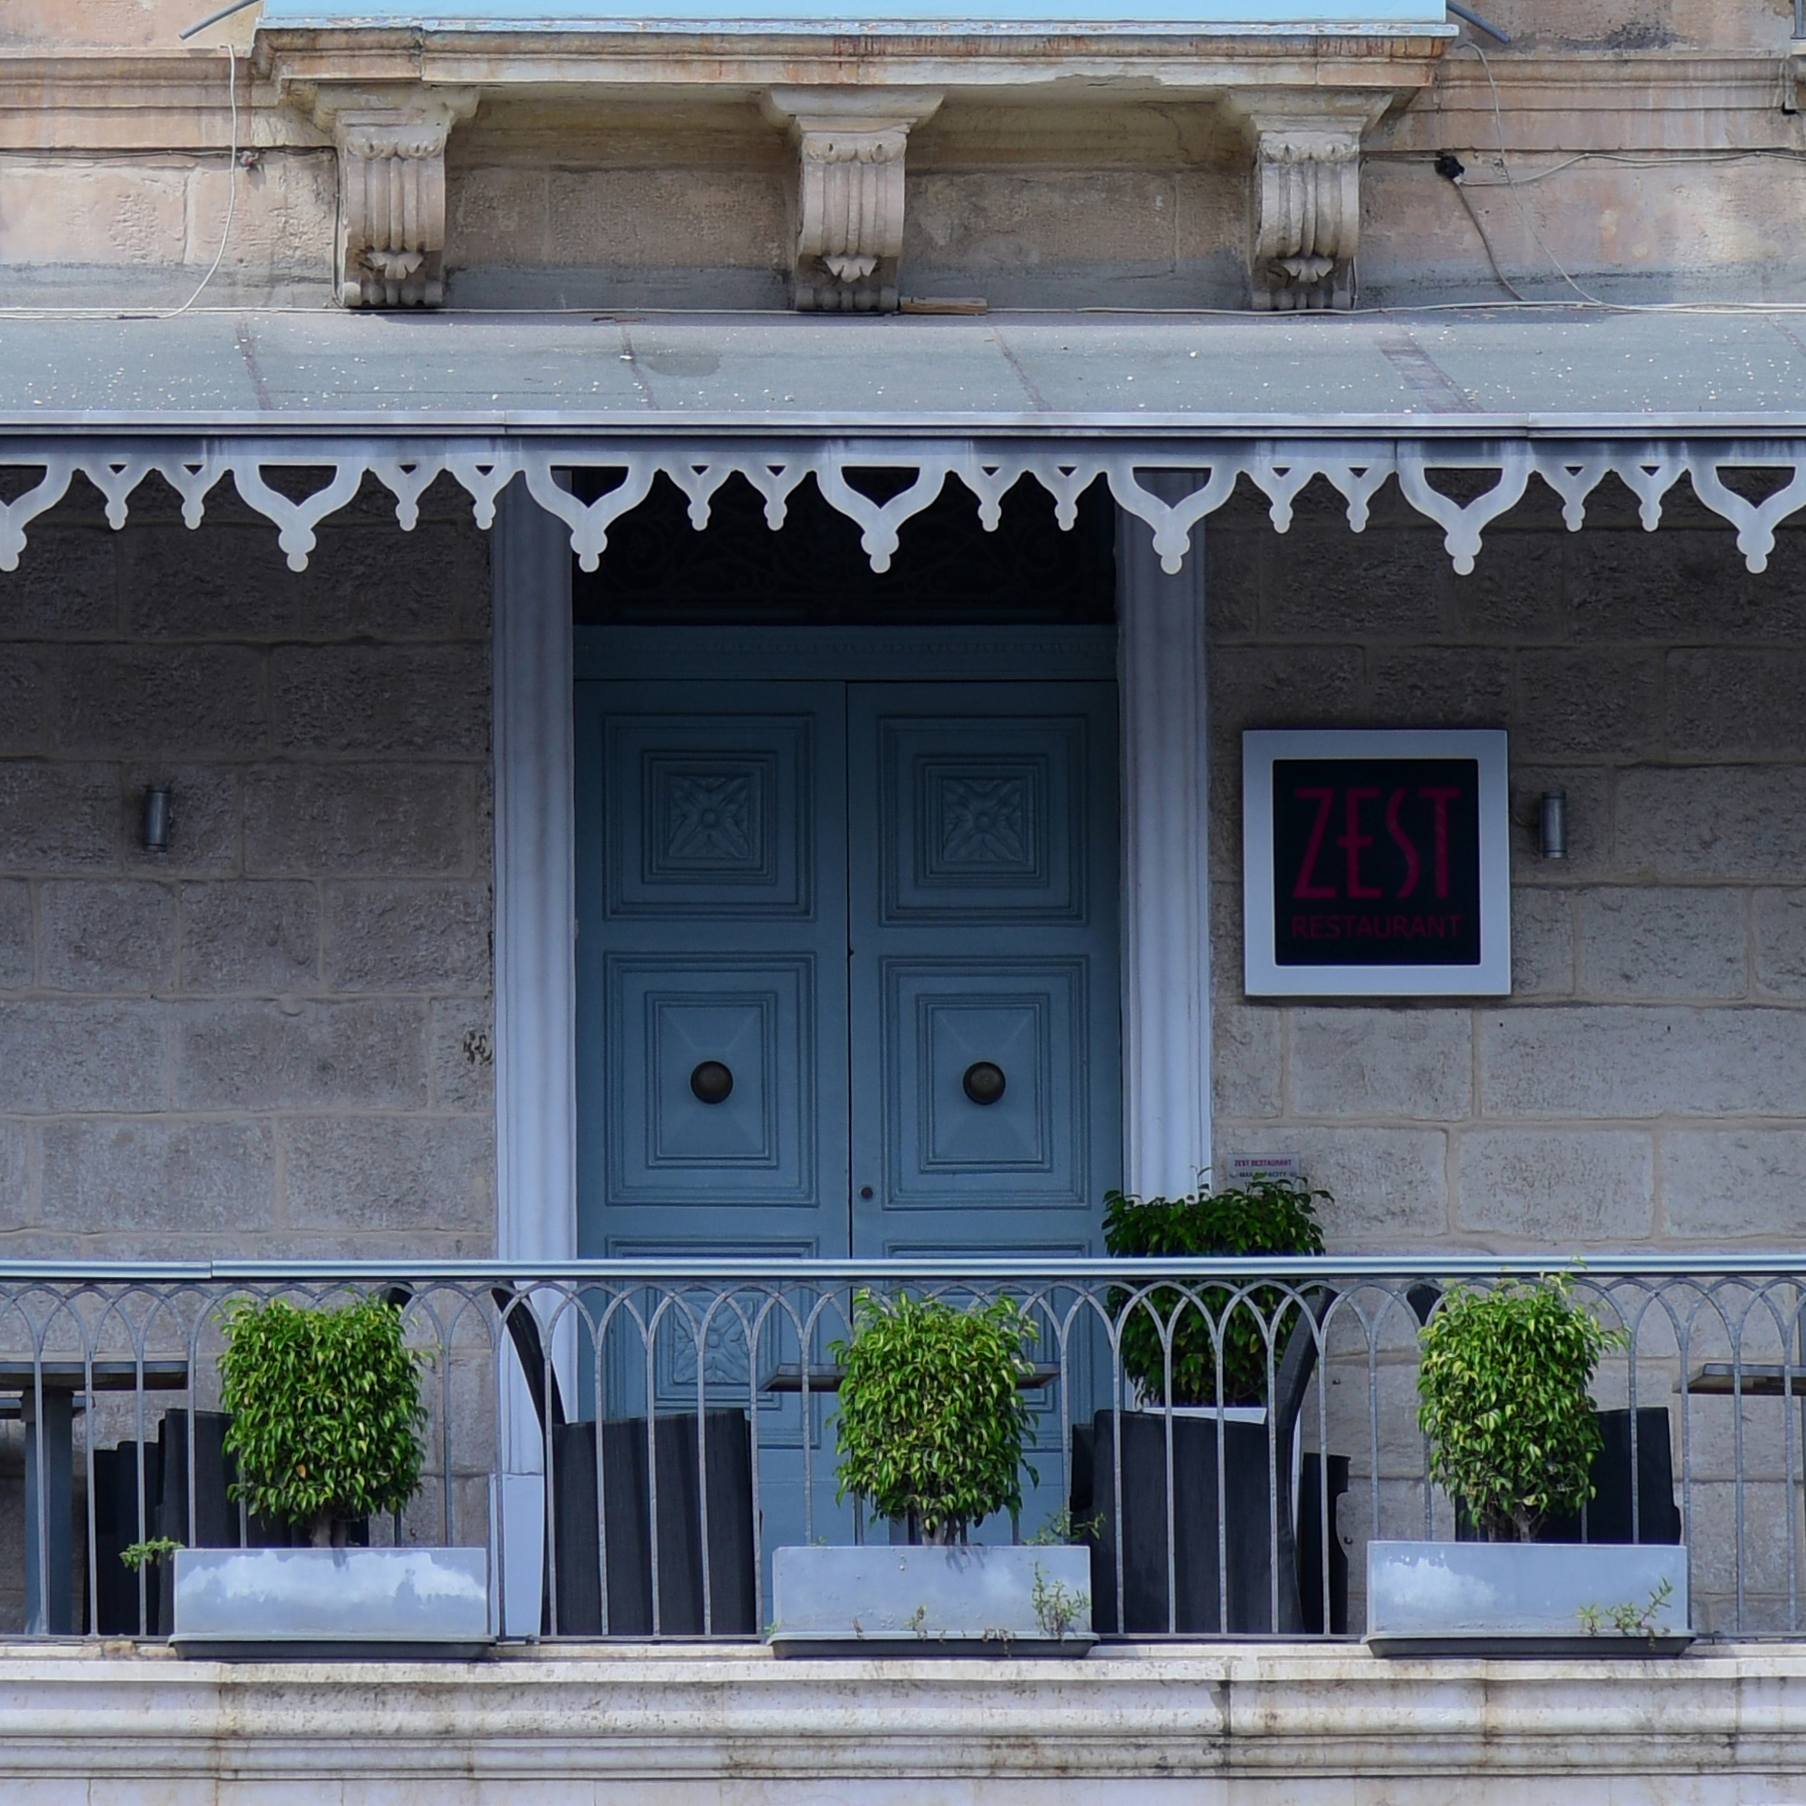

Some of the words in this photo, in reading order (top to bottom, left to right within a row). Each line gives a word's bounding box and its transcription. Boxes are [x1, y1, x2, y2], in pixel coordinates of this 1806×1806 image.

[1293, 787, 1463, 899] ZEST
[1292, 915, 1463, 939] RESTAURANT
[1234, 1159, 1249, 1167] ZEST
[1251, 1159, 1292, 1167] RESTAURANT
